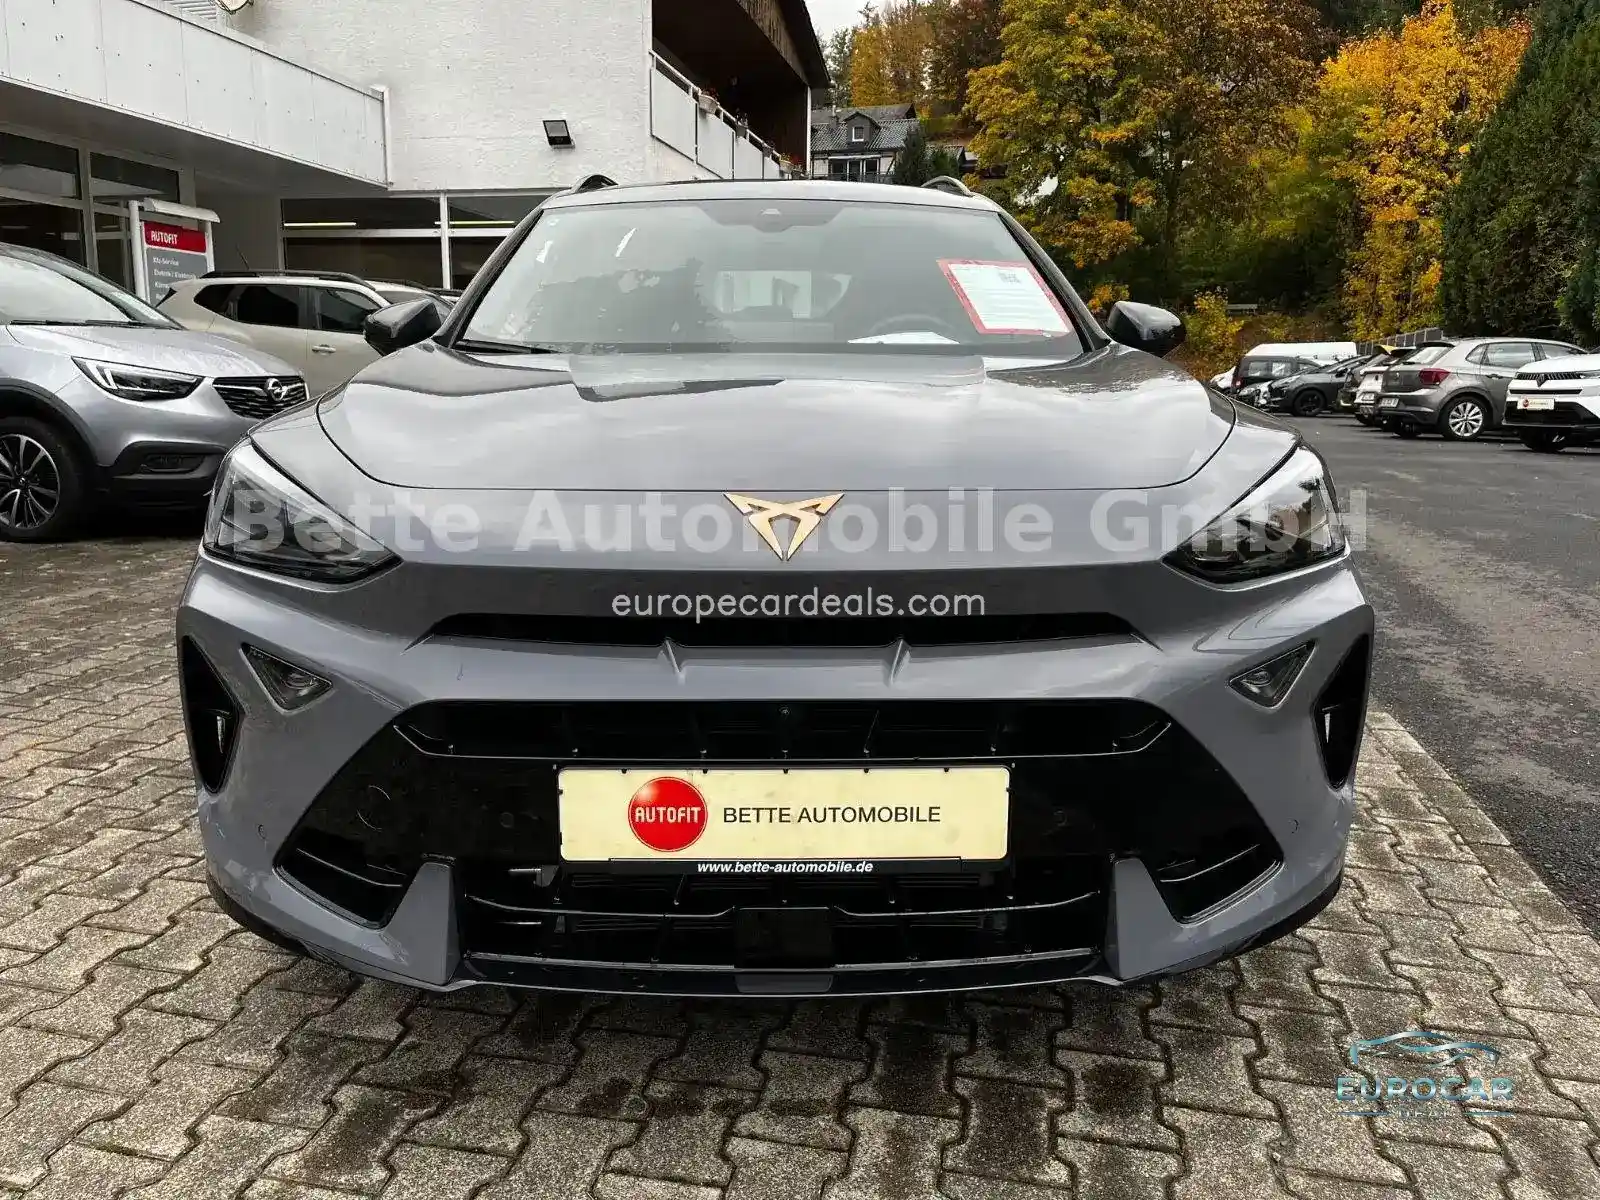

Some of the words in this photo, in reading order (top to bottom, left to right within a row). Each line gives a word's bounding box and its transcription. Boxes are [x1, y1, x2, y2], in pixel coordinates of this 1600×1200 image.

[151, 230, 178, 245] AUTOFIT
[635, 806, 702, 824] AUTOFIT
[723, 807, 792, 823] BETTE
[797, 806, 941, 824] AUTOMOBILE
[697, 860, 874, 874] www.bette-automobile.de
